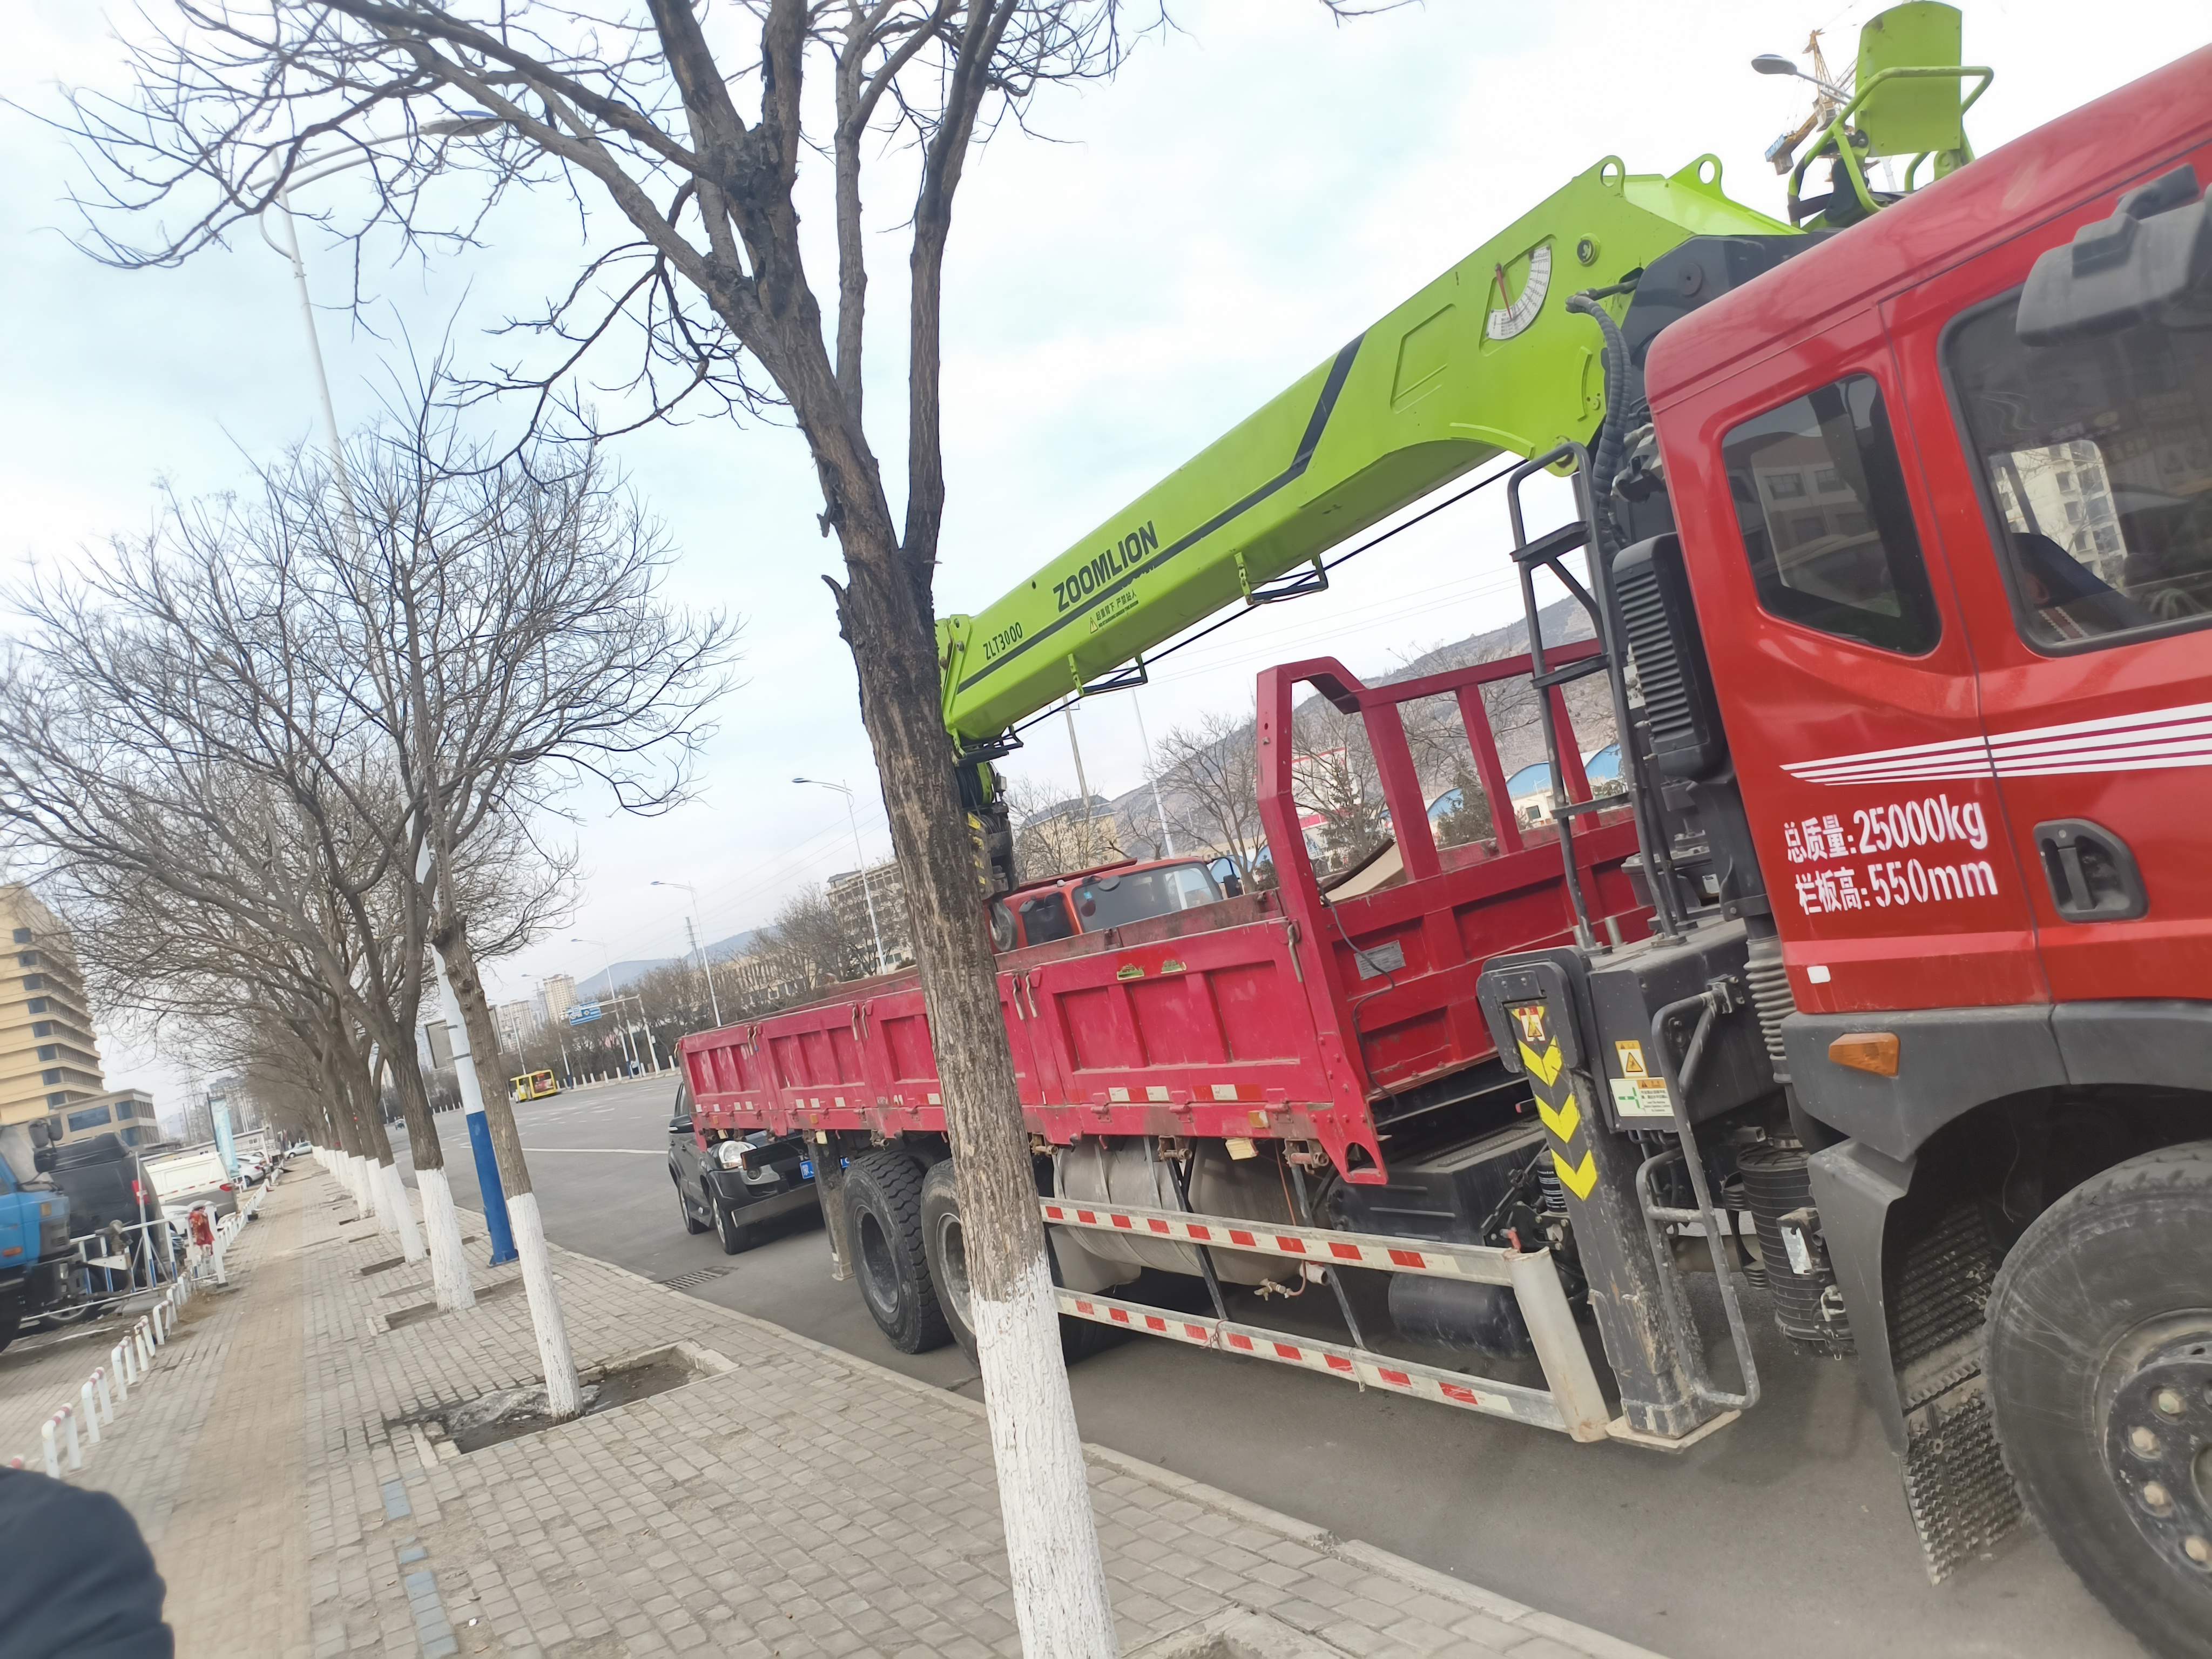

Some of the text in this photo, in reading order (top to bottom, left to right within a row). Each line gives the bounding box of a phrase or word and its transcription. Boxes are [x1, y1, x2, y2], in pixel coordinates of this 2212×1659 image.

[1053, 520, 1158, 613] ZOOMLION
[983, 622, 1023, 660] ZLT3000
[1784, 794, 1988, 864] 总质量:25000kg
[1795, 859, 1998, 915] 栏板高:550mm
